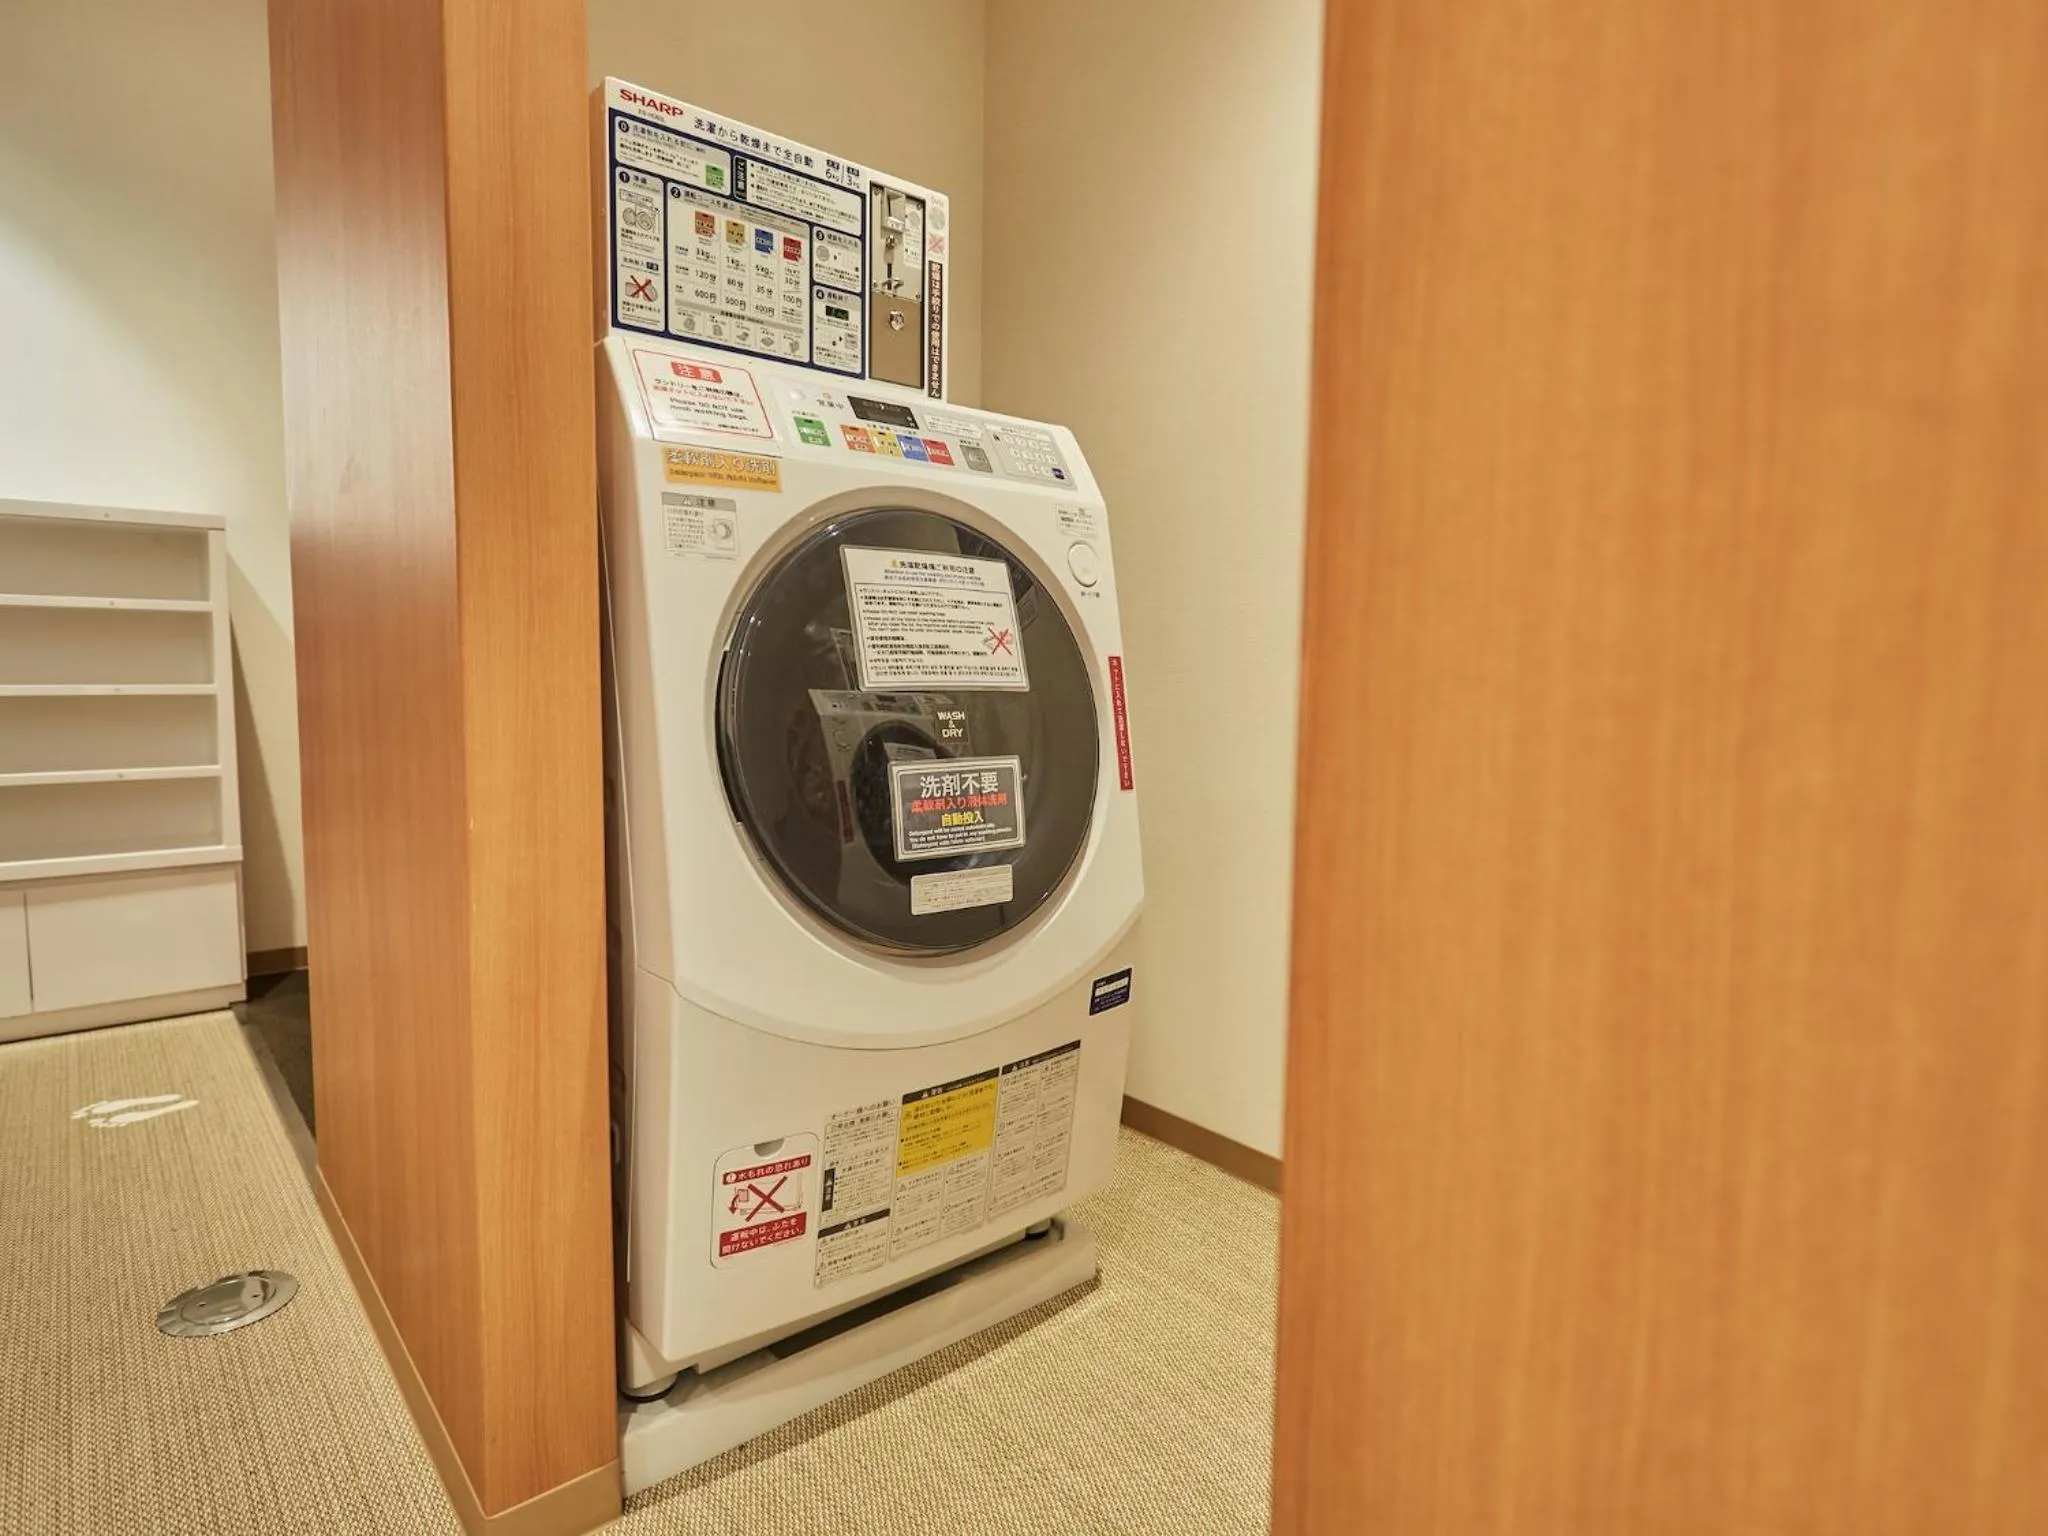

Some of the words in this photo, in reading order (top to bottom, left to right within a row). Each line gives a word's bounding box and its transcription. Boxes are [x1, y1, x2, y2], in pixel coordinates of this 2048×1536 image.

[619, 88, 684, 117] SHARP
[694, 116, 815, 169] 洗濯から乾燥まで全自動
[937, 711, 965, 721] WASH
[948, 720, 956, 728] &
[941, 728, 964, 738] DRY
[920, 771, 999, 799] 洗剤不要
[941, 810, 984, 827] 自動投入
[730, 1217, 797, 1242] 運転中は、ふたを
